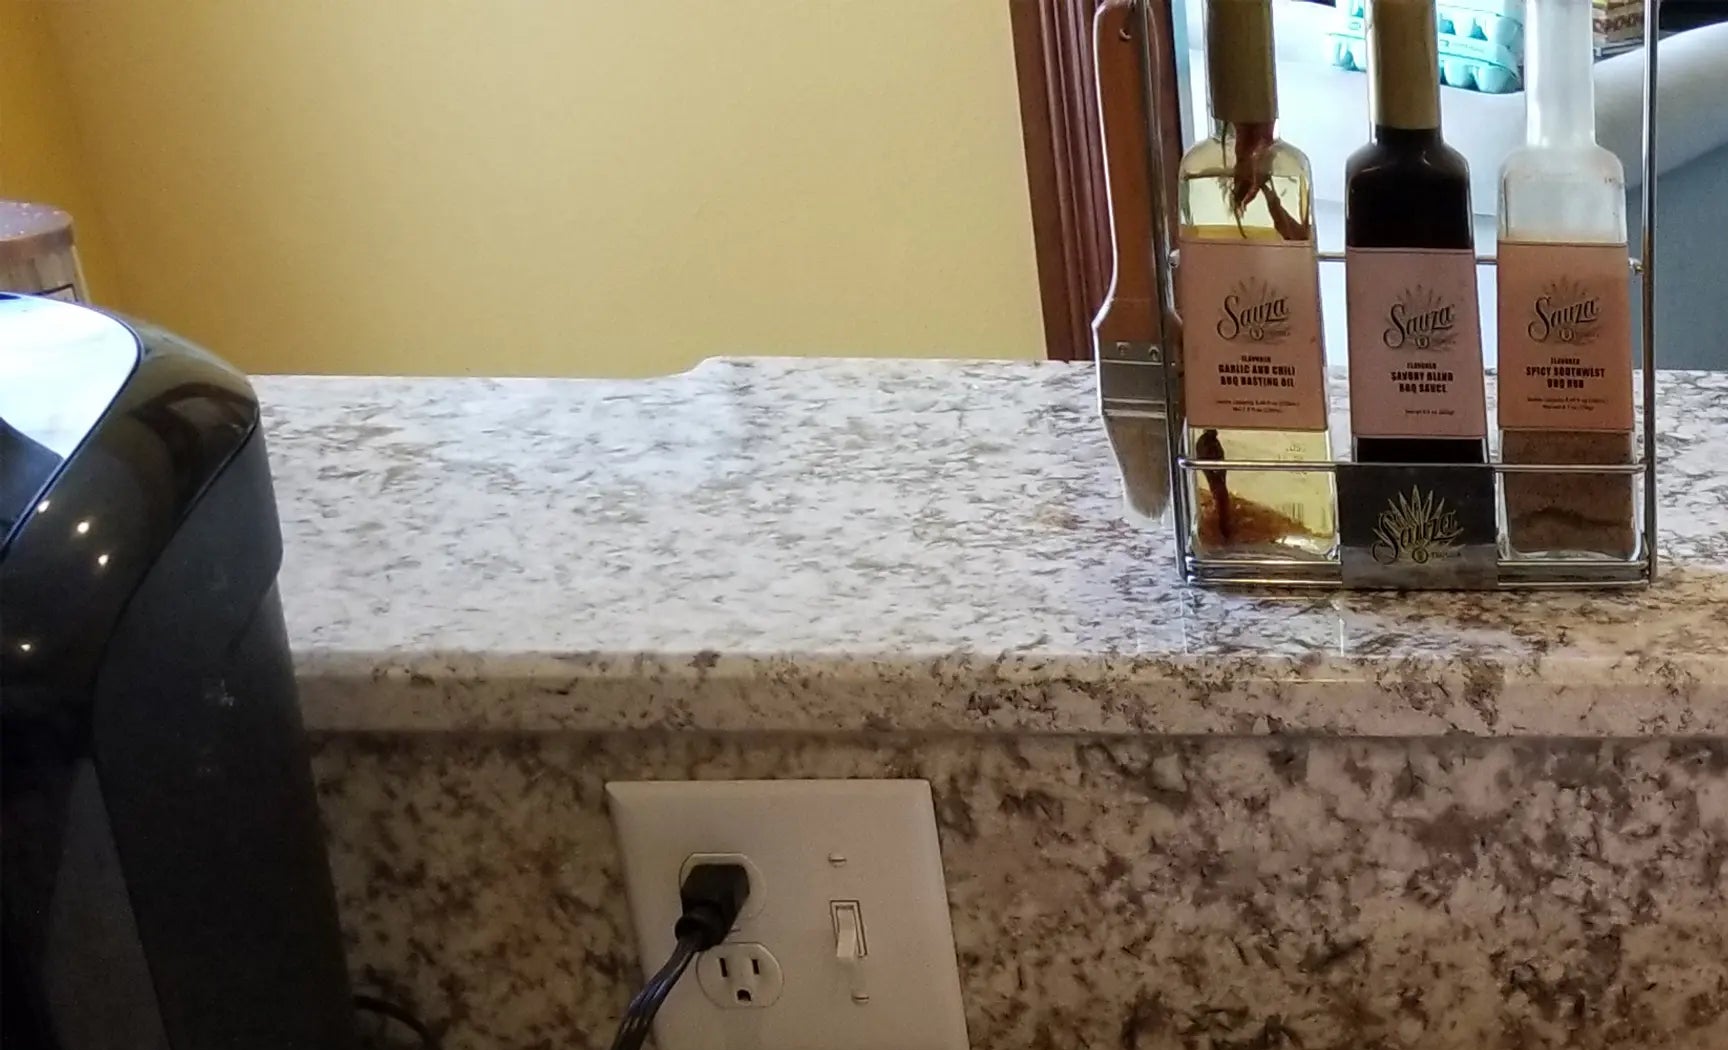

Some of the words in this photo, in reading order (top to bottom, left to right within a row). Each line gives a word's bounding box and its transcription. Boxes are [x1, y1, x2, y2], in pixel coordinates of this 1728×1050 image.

[1217, 295, 1288, 340] Sauza
[1527, 297, 1599, 342] Sauza
[1383, 303, 1454, 348] Sauza
[1218, 364, 1250, 373] GARLIC
[1252, 364, 1270, 374] AND
[1272, 366, 1296, 375] CHILI
[1526, 367, 1552, 376] SPICY
[1554, 367, 1605, 377] SOUTHWEST
[1220, 376, 1238, 386] BBQ
[1241, 376, 1279, 386] BASTING
[1281, 378, 1295, 387] OIL
[1391, 371, 1424, 381] SAVORY
[1427, 372, 1453, 381] BLEND
[1399, 383, 1417, 393] BBQ
[1419, 384, 1448, 393] SAUCE
[1547, 379, 1565, 388] BBQ
[1567, 379, 1584, 388] RUB
[1372, 512, 1458, 564] Sauza
